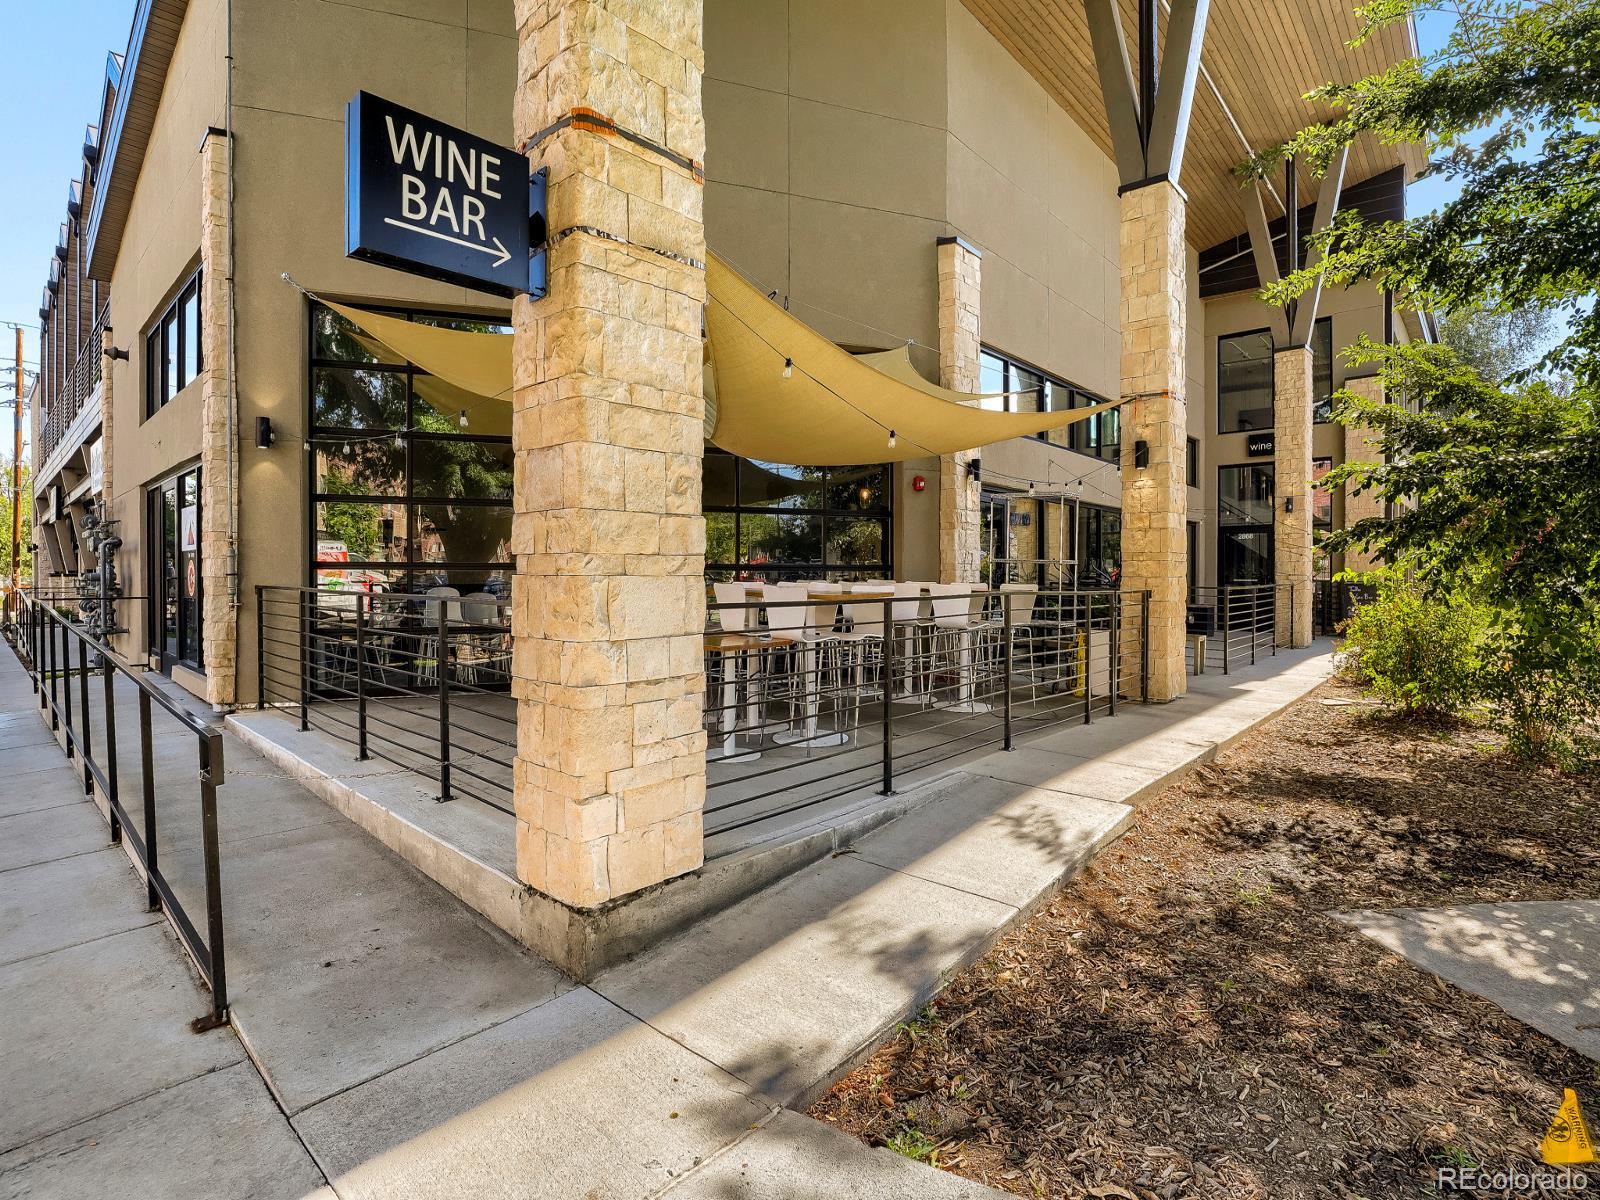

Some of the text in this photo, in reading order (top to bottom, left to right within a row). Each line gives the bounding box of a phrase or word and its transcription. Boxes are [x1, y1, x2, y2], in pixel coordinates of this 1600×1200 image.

[385, 115, 502, 200] WINE
[402, 174, 486, 240] BAR
[1250, 441, 1273, 451] wine
[1567, 1106, 1587, 1150] WARNING
